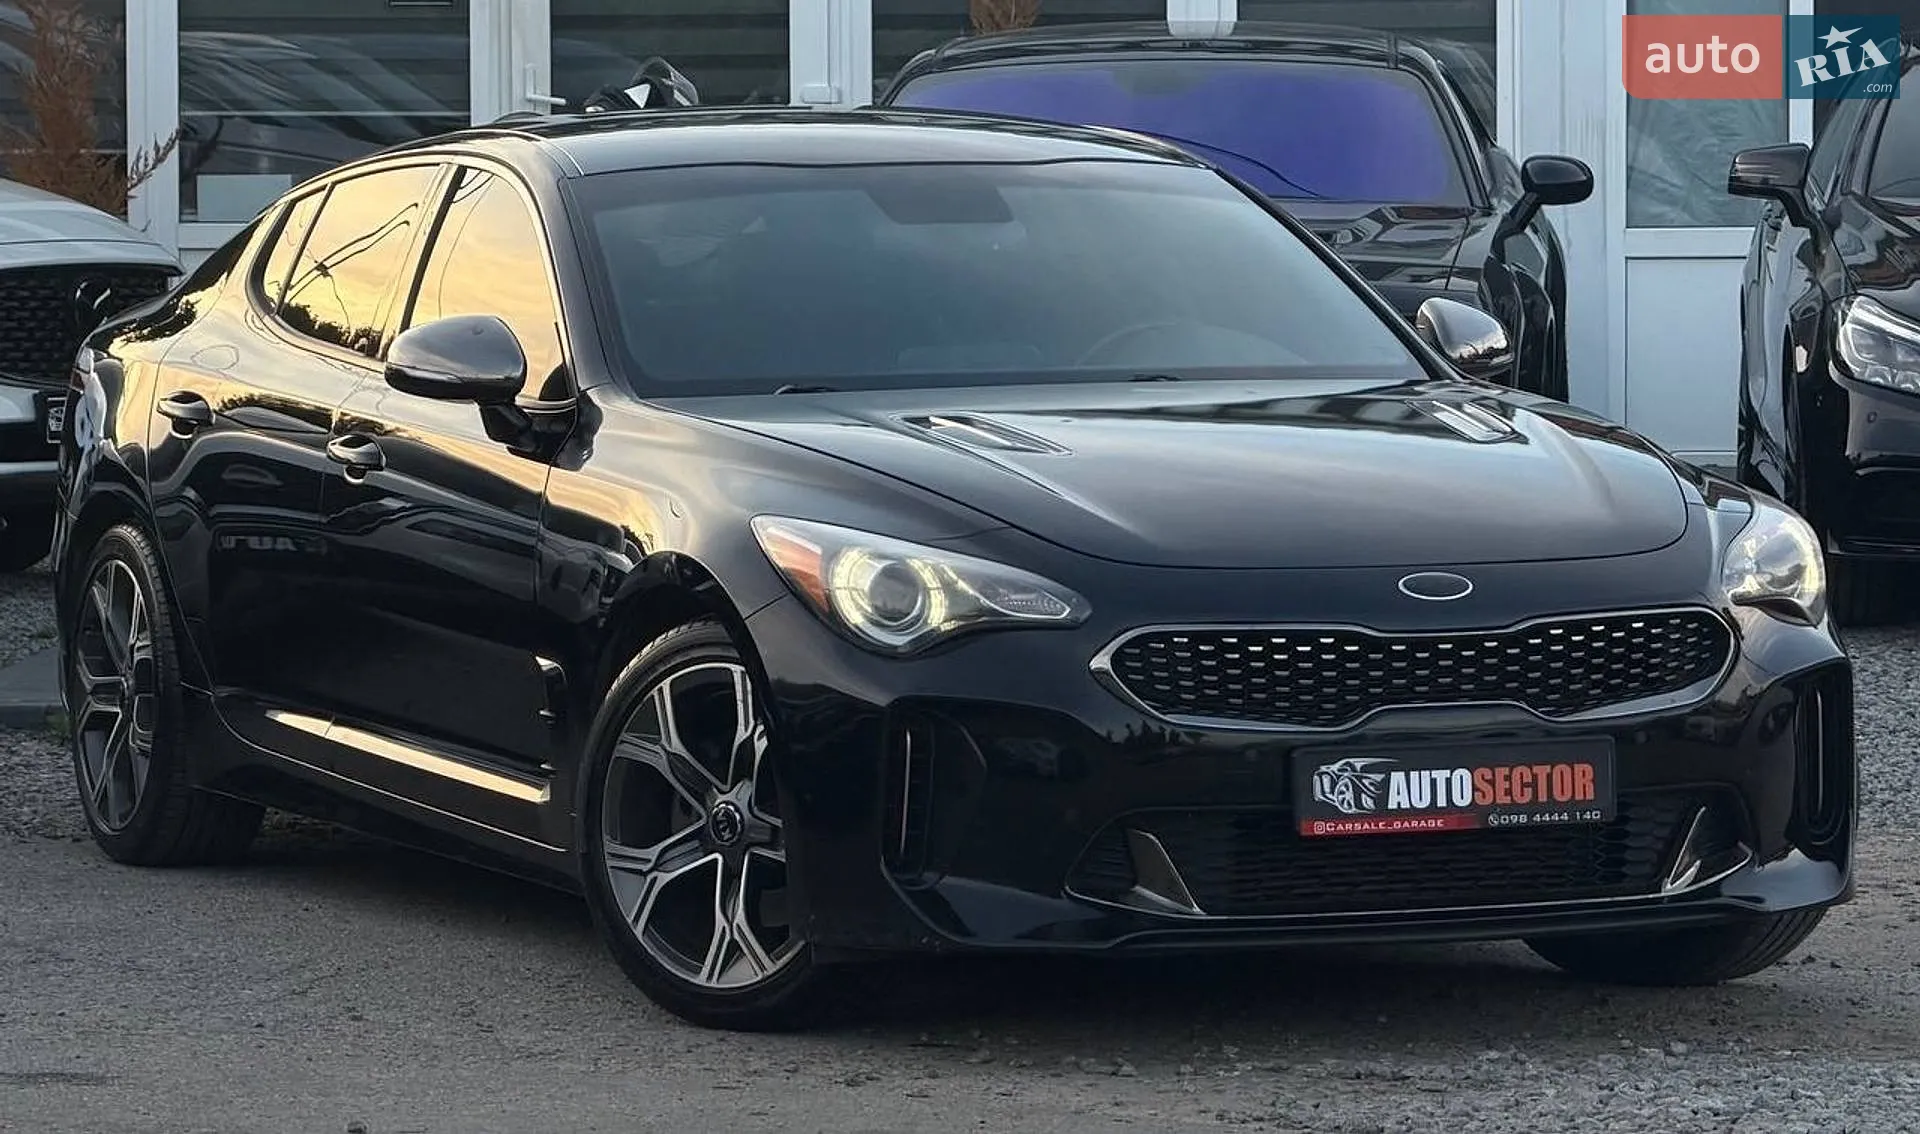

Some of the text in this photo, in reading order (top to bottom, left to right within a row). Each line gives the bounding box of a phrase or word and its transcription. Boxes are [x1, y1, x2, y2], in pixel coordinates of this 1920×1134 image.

[1500, 810, 1601, 825] 098 4444 140
